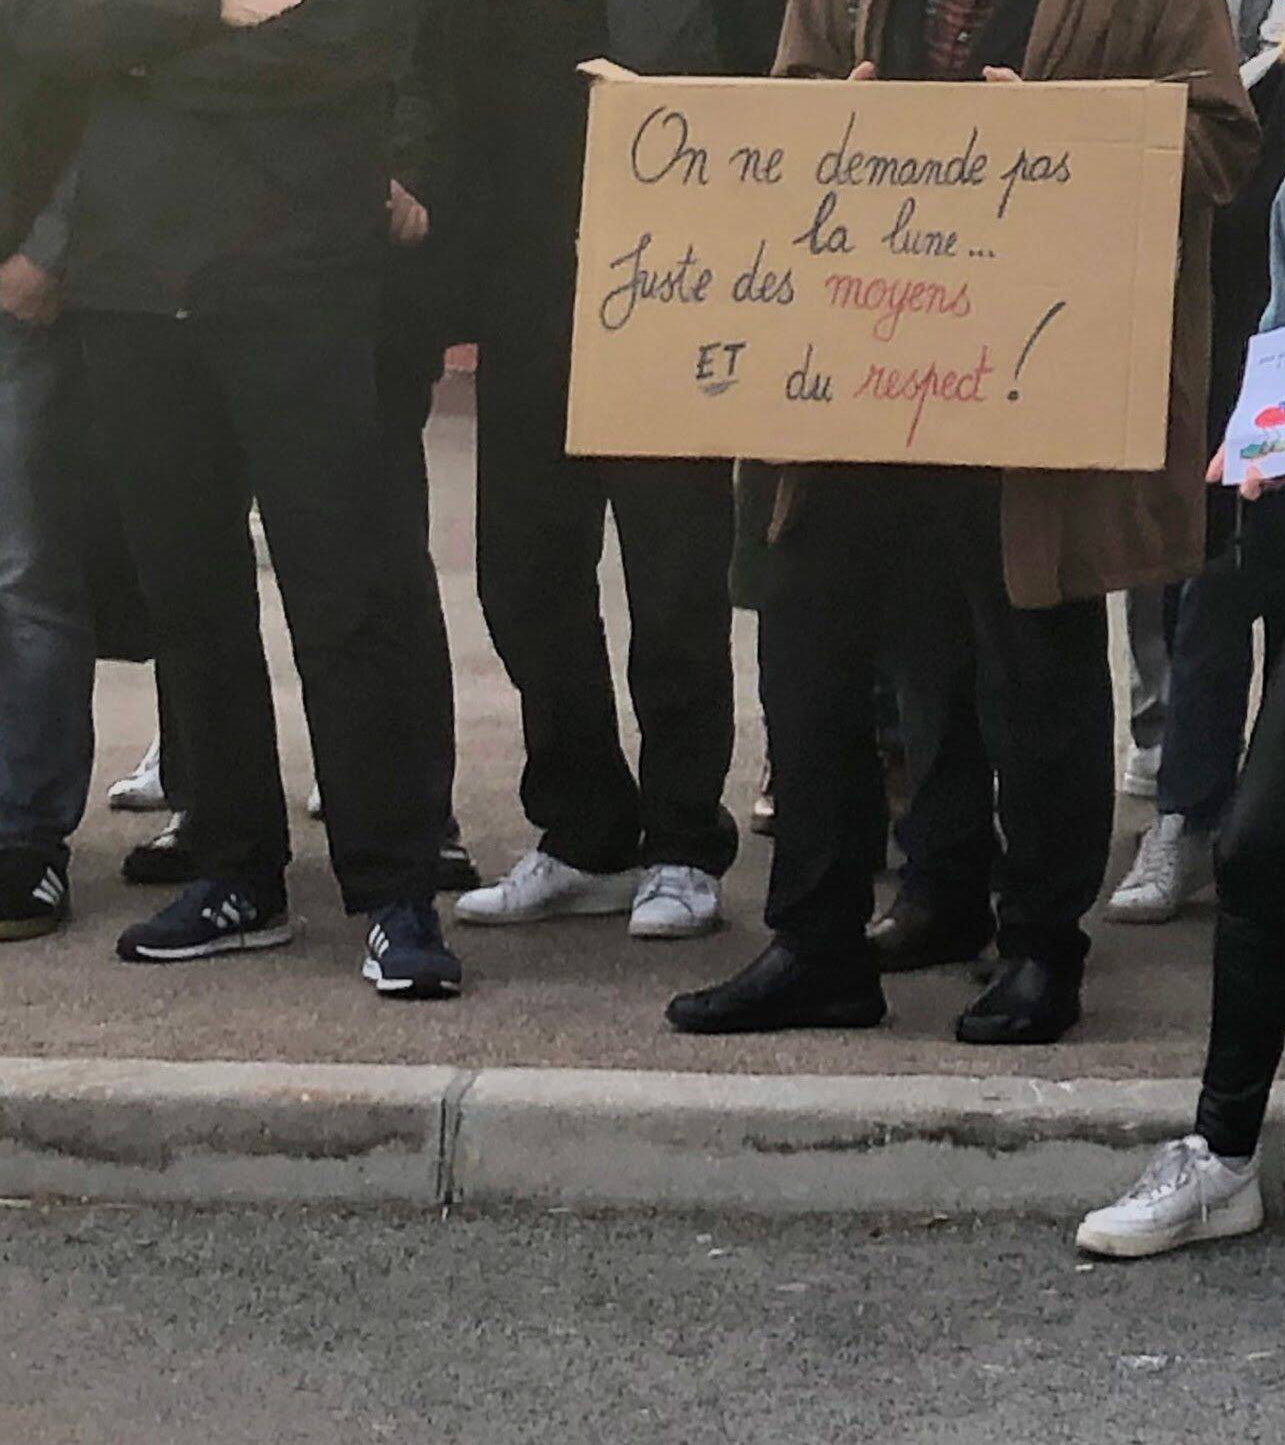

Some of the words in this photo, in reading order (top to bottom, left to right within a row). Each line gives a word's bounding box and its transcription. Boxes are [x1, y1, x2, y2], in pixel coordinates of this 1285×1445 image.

[631, 106, 708, 185] On
[728, 147, 784, 185] ne
[816, 112, 987, 187] demande
[997, 148, 1072, 219] pas
[793, 190, 854, 255] la
[881, 196, 997, 258] lune...
[599, 233, 710, 331] Juste
[732, 238, 796, 305] des
[825, 274, 973, 343] moyens
[694, 342, 747, 381] ET
[785, 344, 833, 403] du
